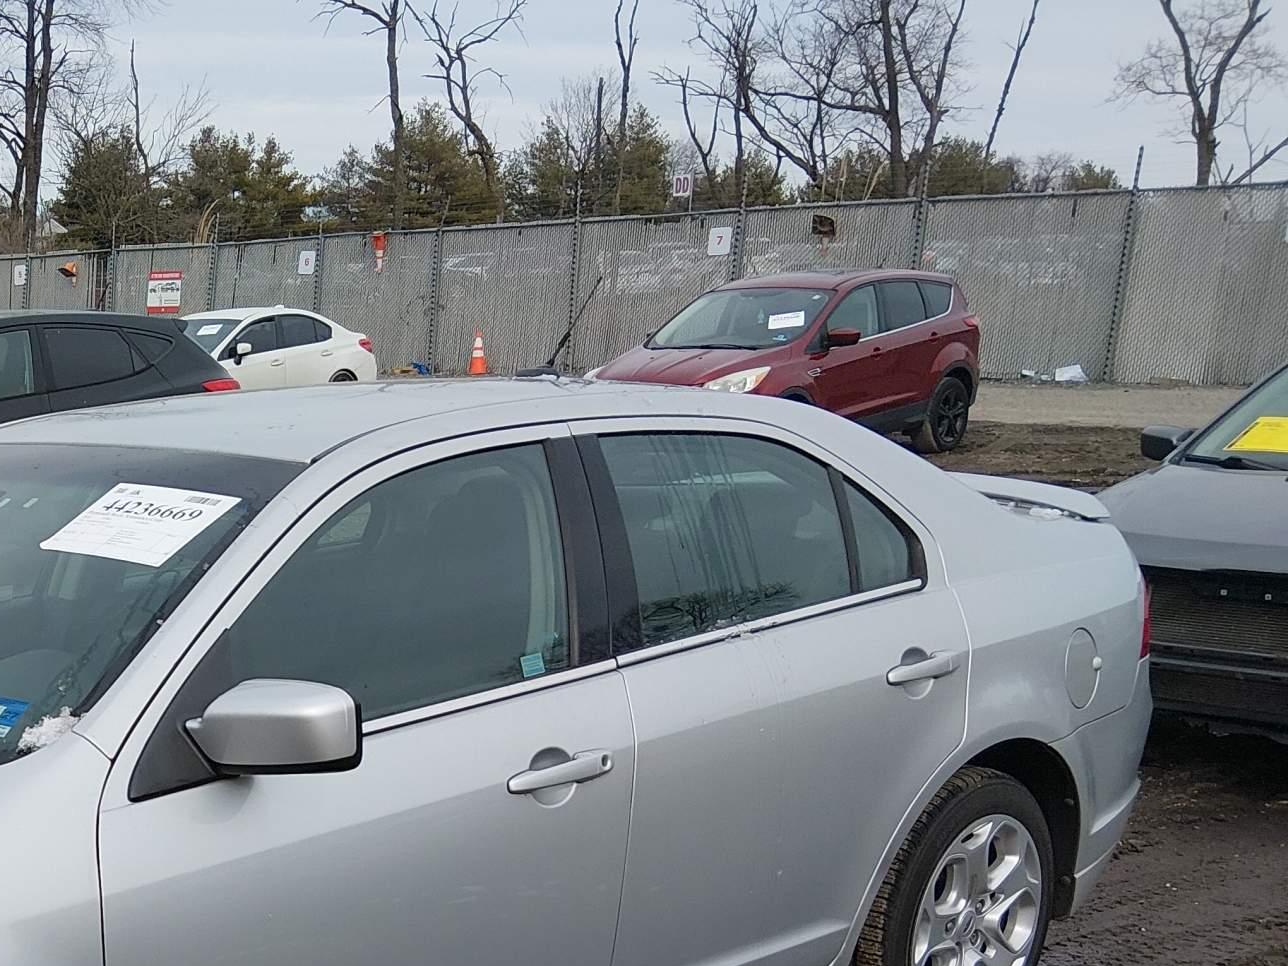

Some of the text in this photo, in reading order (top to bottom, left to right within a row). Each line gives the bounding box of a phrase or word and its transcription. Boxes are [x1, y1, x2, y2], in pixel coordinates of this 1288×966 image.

[675, 177, 690, 194] DD
[716, 235, 723, 245] 7
[103, 499, 204, 522] 44236669
